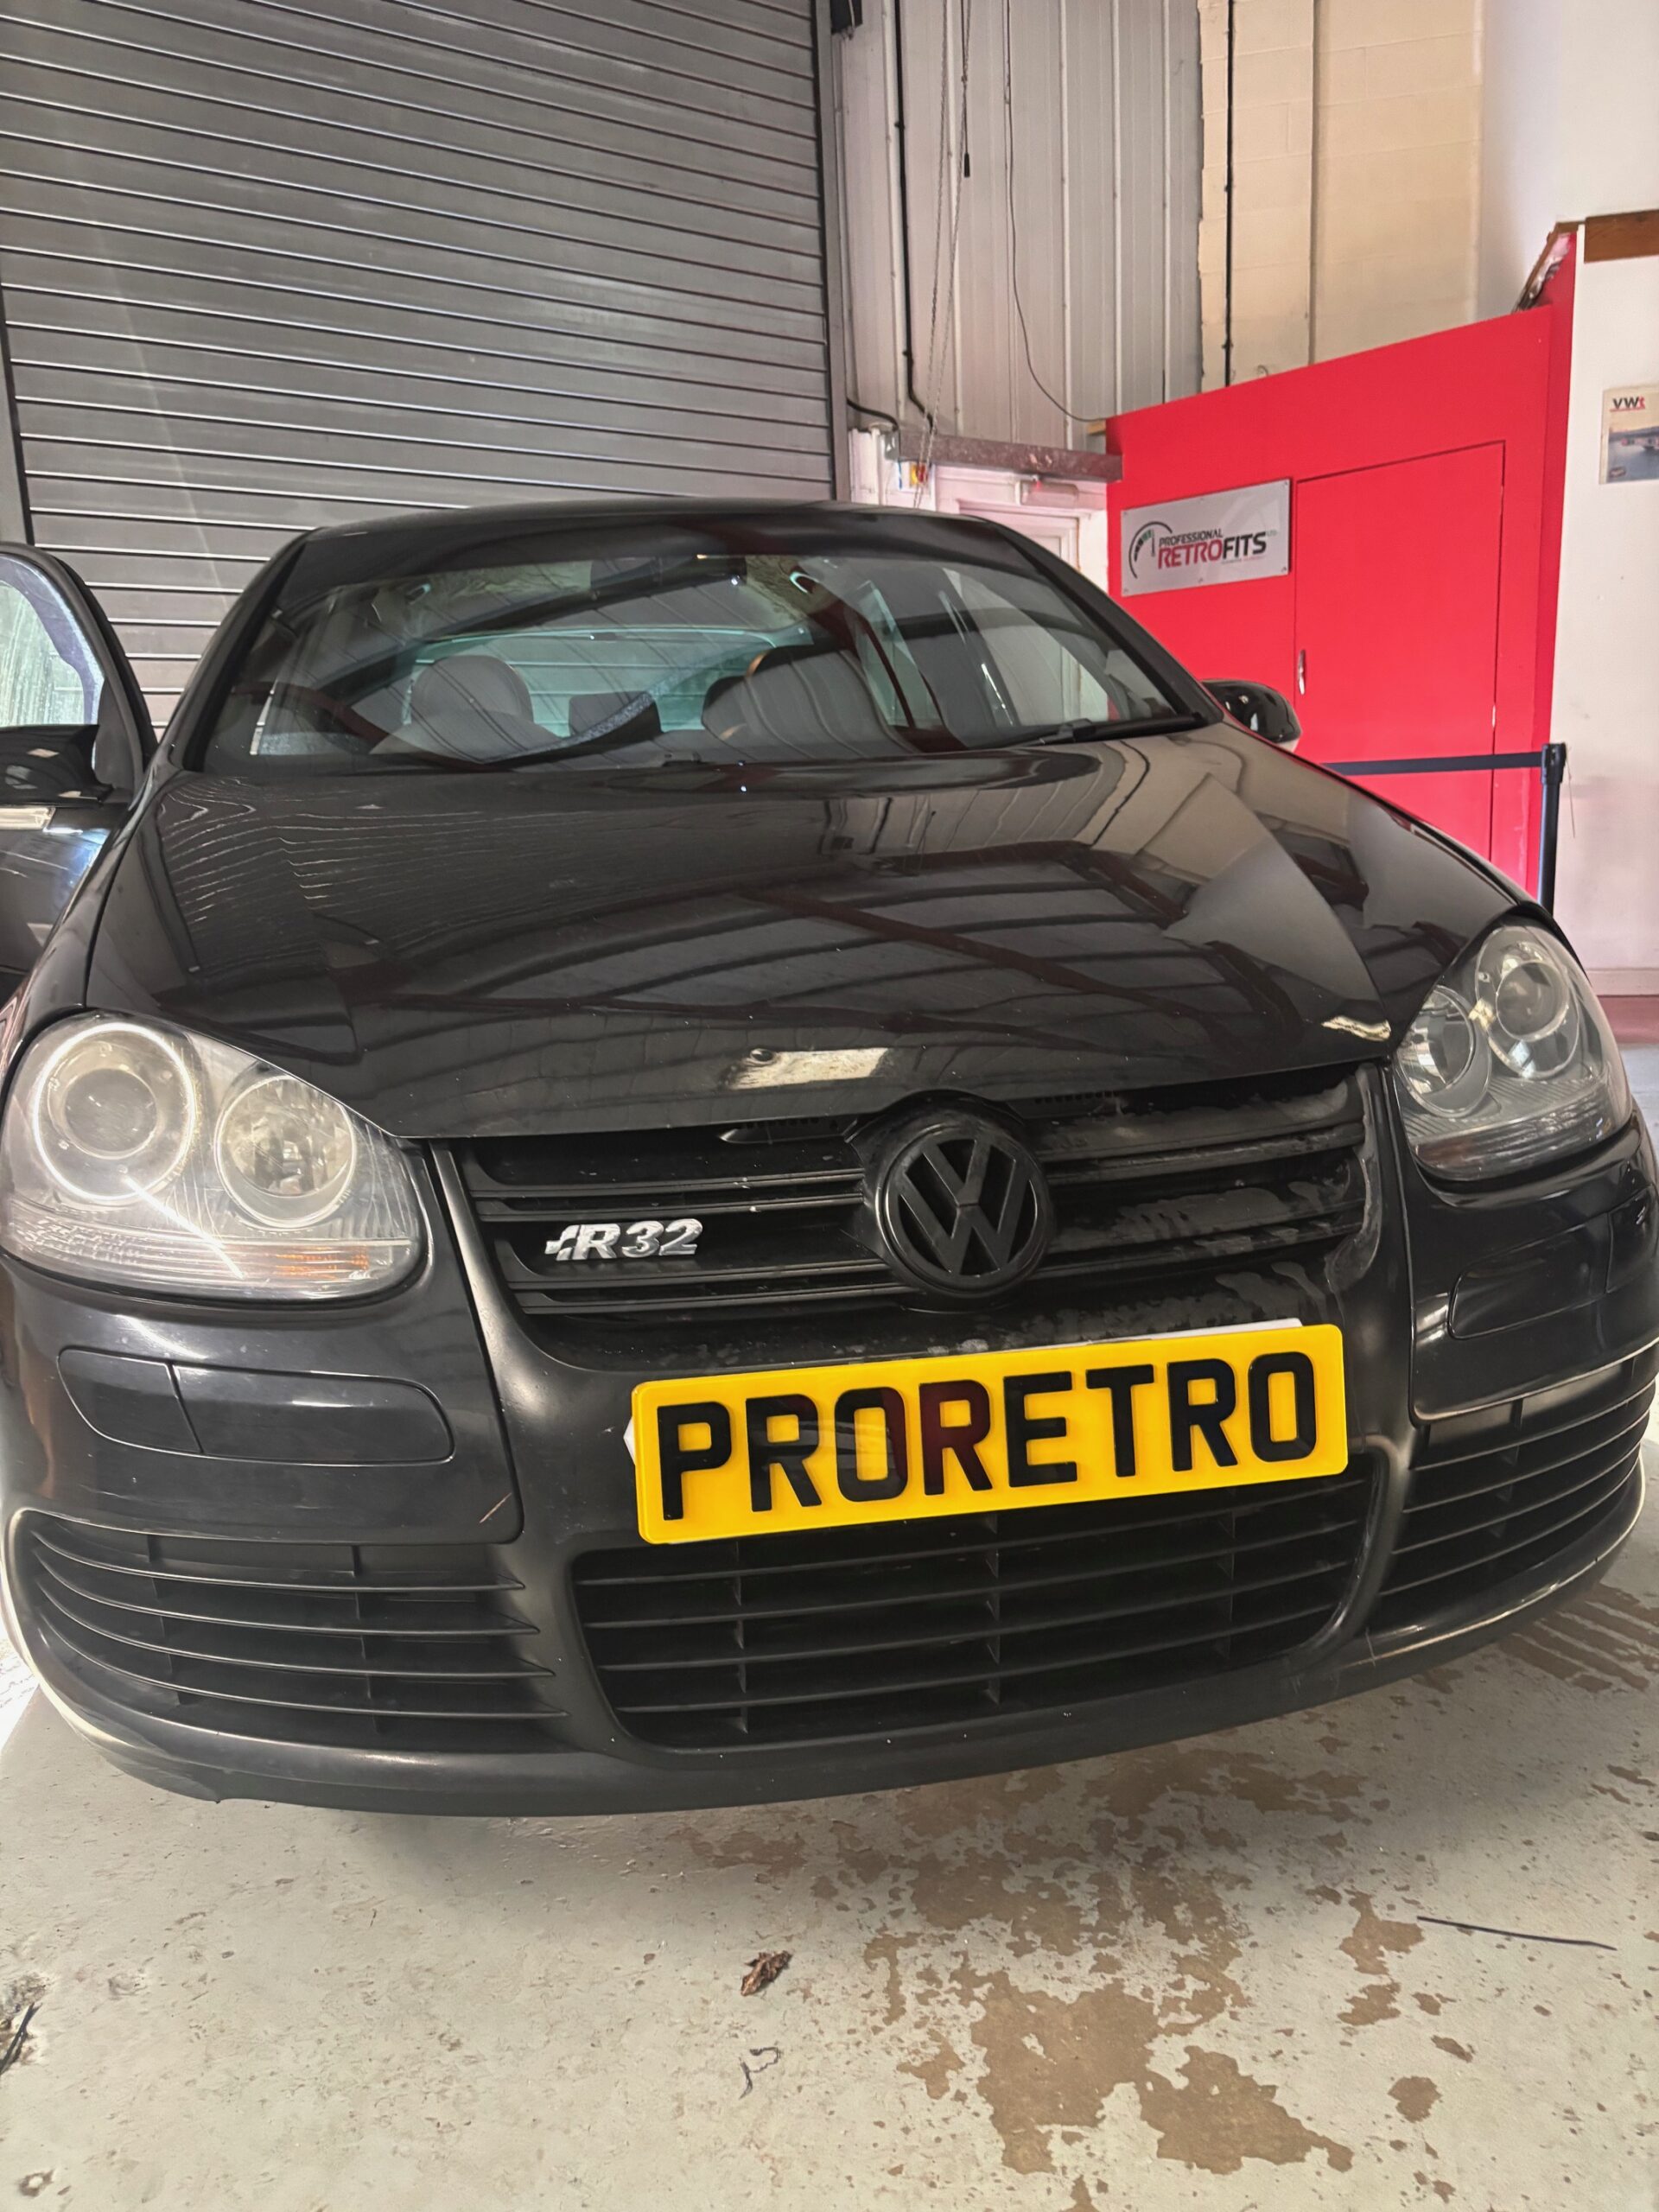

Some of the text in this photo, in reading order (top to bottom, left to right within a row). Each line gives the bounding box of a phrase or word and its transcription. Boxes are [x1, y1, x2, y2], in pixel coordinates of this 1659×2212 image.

[1158, 531, 1267, 569] RETROFITS
[1159, 528, 1224, 547] PROFESSIONAL
[562, 1218, 703, 1261] R32
[657, 1351, 1317, 1521] PRORETRO
